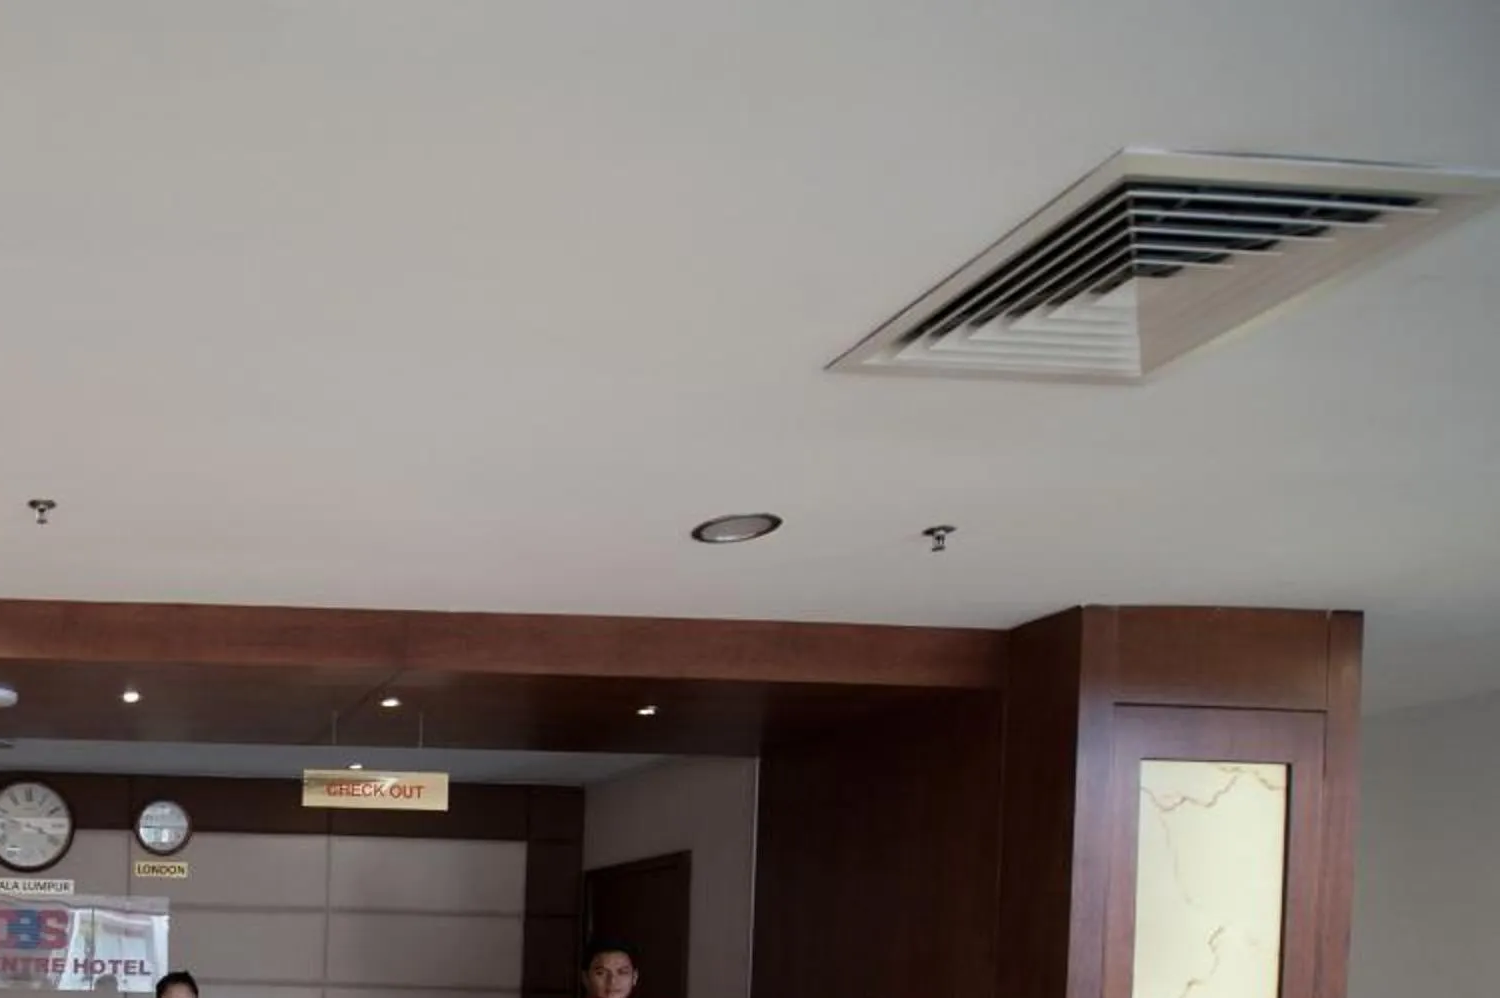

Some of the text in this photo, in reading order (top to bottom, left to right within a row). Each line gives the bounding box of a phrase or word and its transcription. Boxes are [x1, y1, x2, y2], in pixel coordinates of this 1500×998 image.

[326, 783, 424, 799] CHECK OUT
[137, 863, 186, 876] LONDON
[22, 881, 70, 892] LUMPUR
[73, 957, 152, 976] HOTEL
